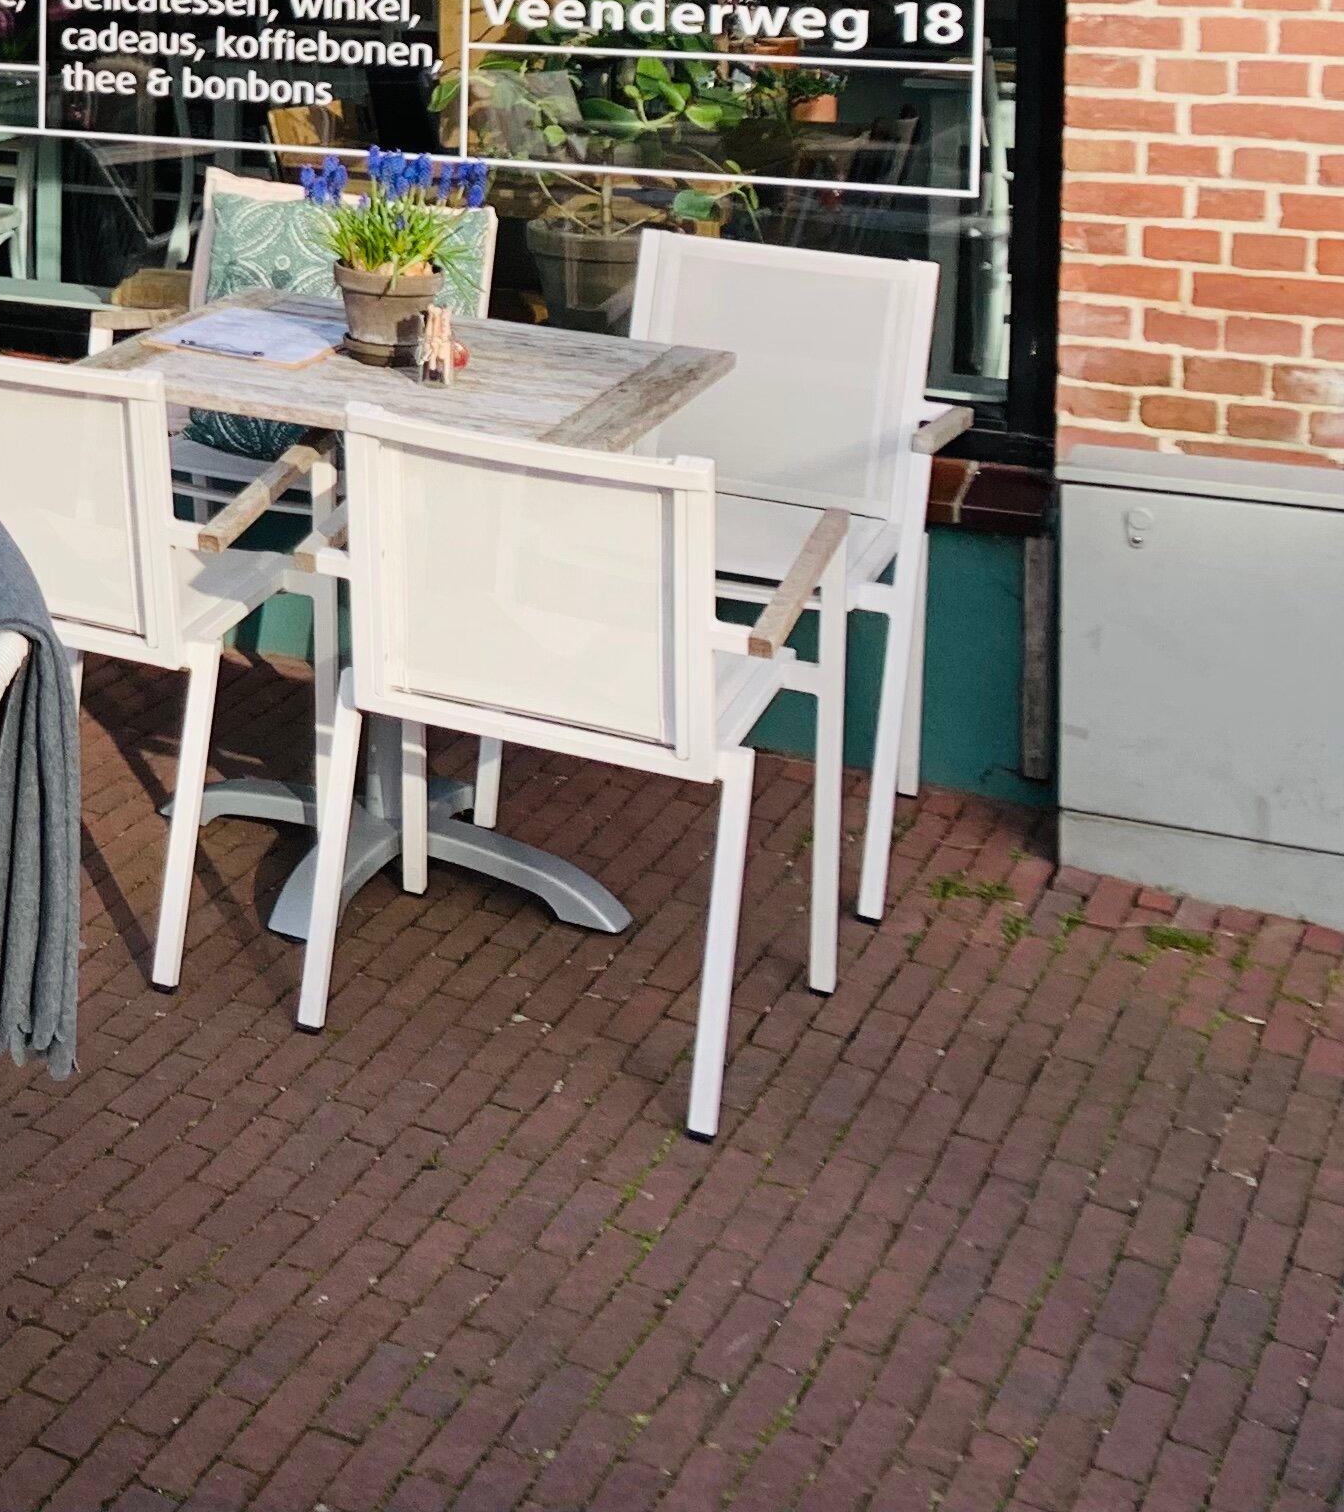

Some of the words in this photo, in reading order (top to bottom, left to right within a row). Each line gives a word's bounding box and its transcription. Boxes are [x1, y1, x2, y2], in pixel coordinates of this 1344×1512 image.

[893, 1, 964, 46] 18
[61, 22, 206, 62] cadeaus,
[216, 26, 444, 74] koffiebonen,
[61, 62, 137, 95] thee
[146, 68, 174, 97] &
[182, 67, 334, 106] bonbons
